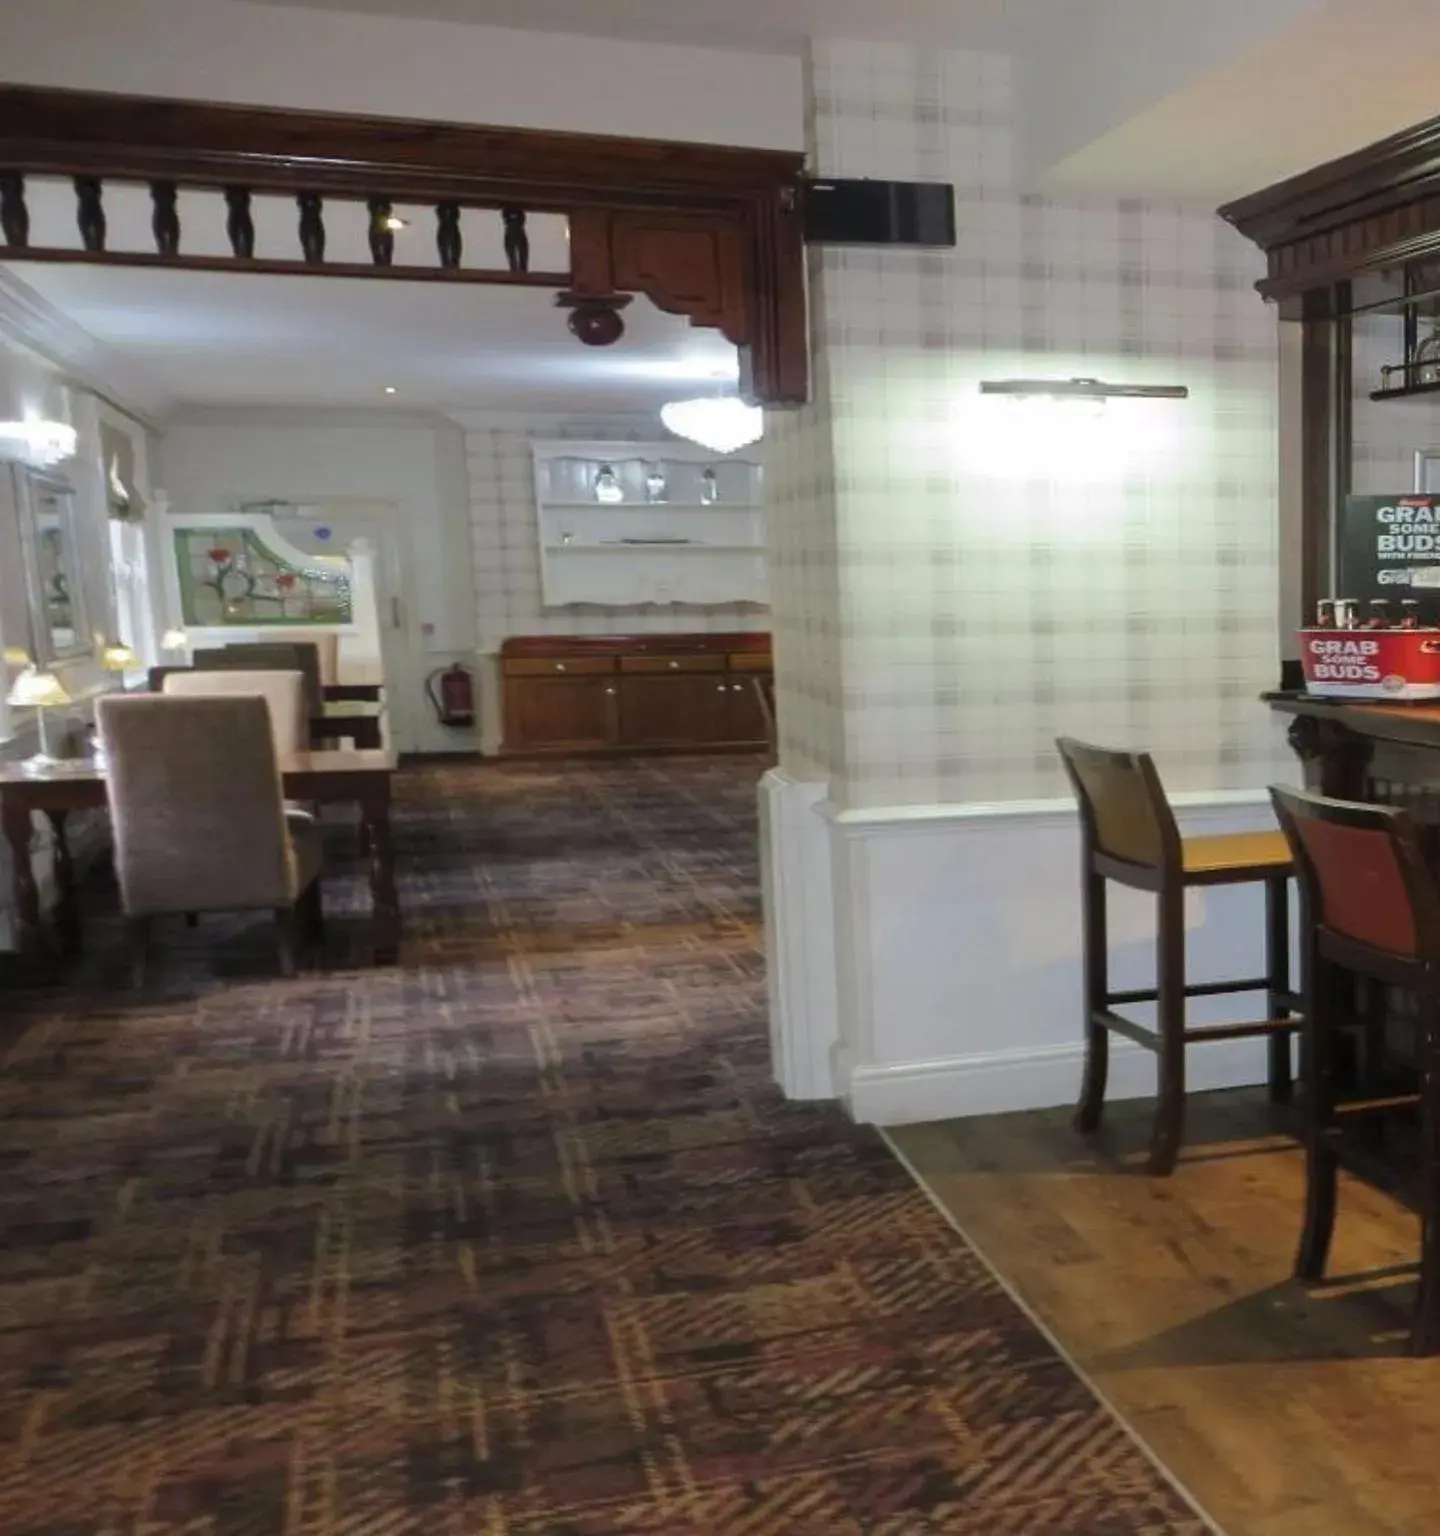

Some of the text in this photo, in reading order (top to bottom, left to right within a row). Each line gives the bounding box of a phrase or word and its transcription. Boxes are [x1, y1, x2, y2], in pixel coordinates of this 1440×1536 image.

[1389, 523, 1440, 535] SOME
[1309, 640, 1380, 656] GRAB
[1321, 654, 1368, 666] SOME
[1313, 664, 1380, 680] BUDS
